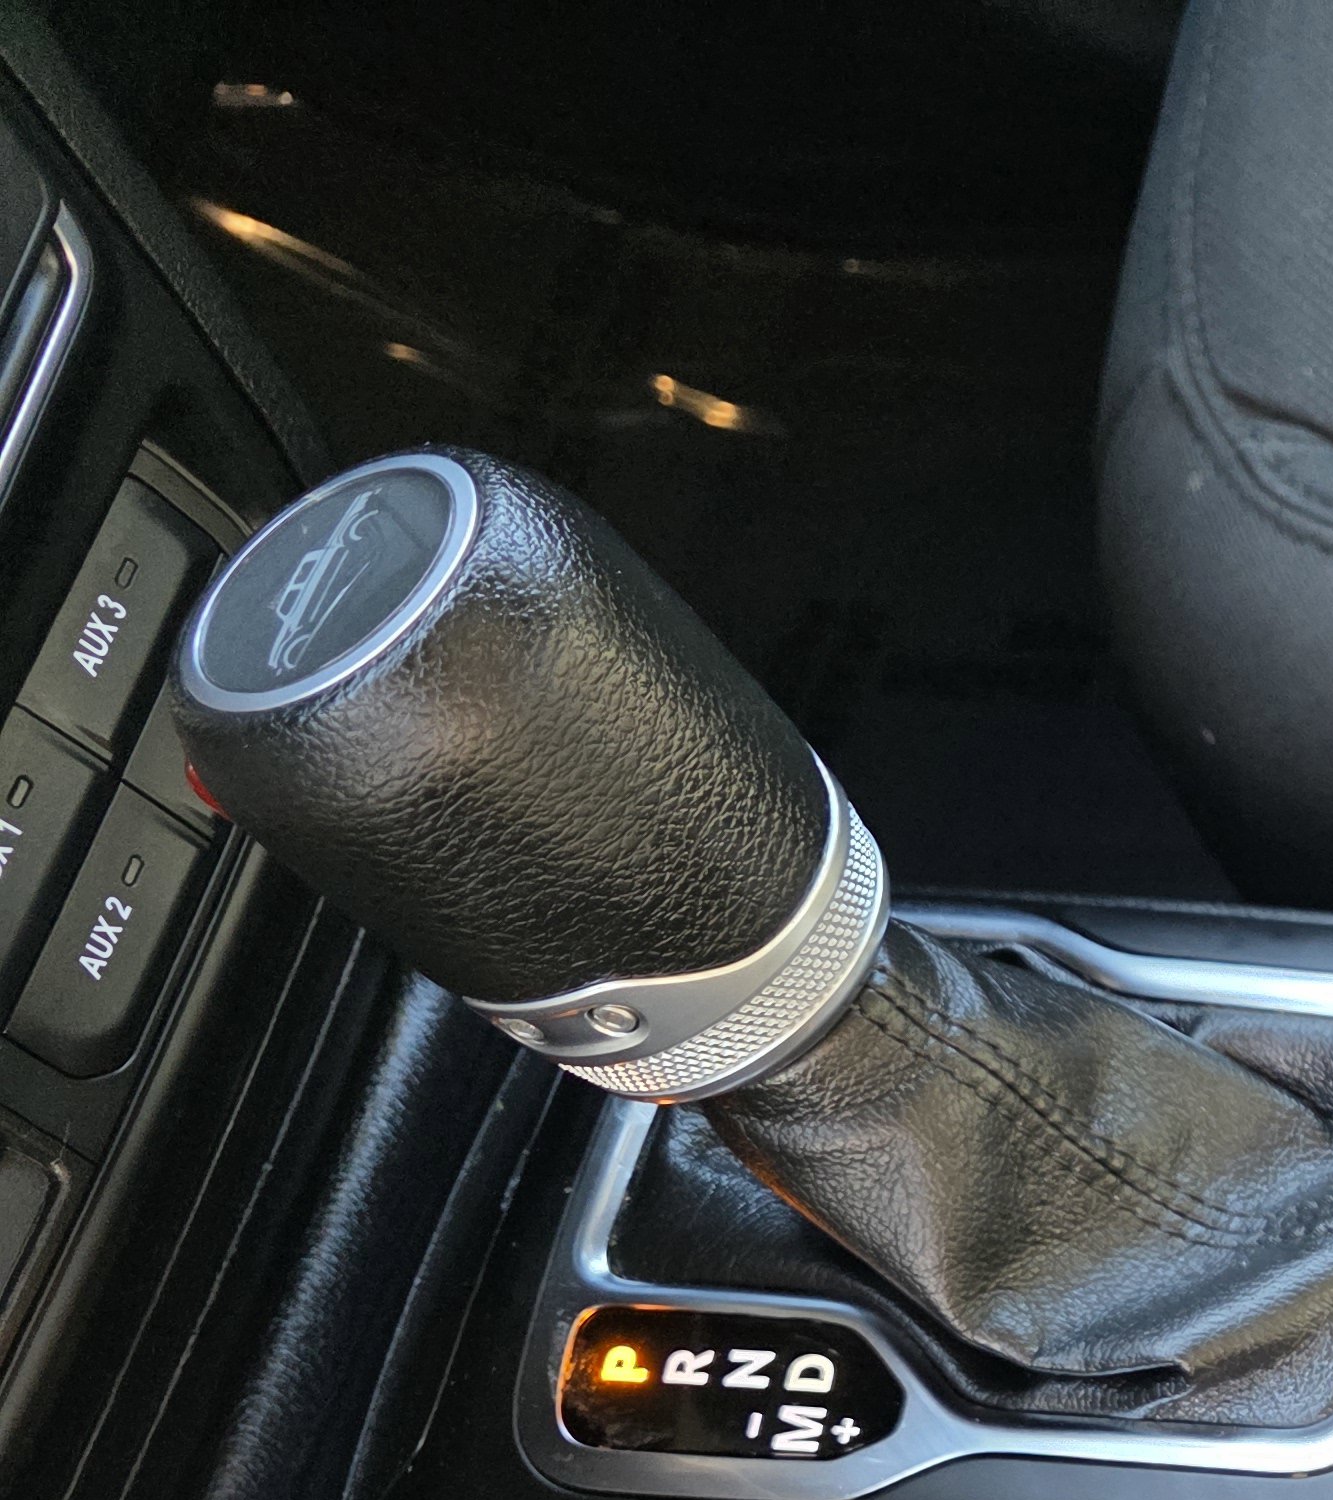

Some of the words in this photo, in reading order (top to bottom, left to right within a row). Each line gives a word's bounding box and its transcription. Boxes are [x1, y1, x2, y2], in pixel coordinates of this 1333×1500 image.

[73, 611, 119, 678] AUX
[97, 594, 127, 619] 3
[79, 914, 124, 981] AUX
[105, 896, 133, 921] 2
[601, 1345, 649, 1383] P
[662, 1350, 715, 1386] R
[722, 1349, 776, 1389] N
[783, 1353, 835, 1393] D
[771, 1404, 828, 1453] M
